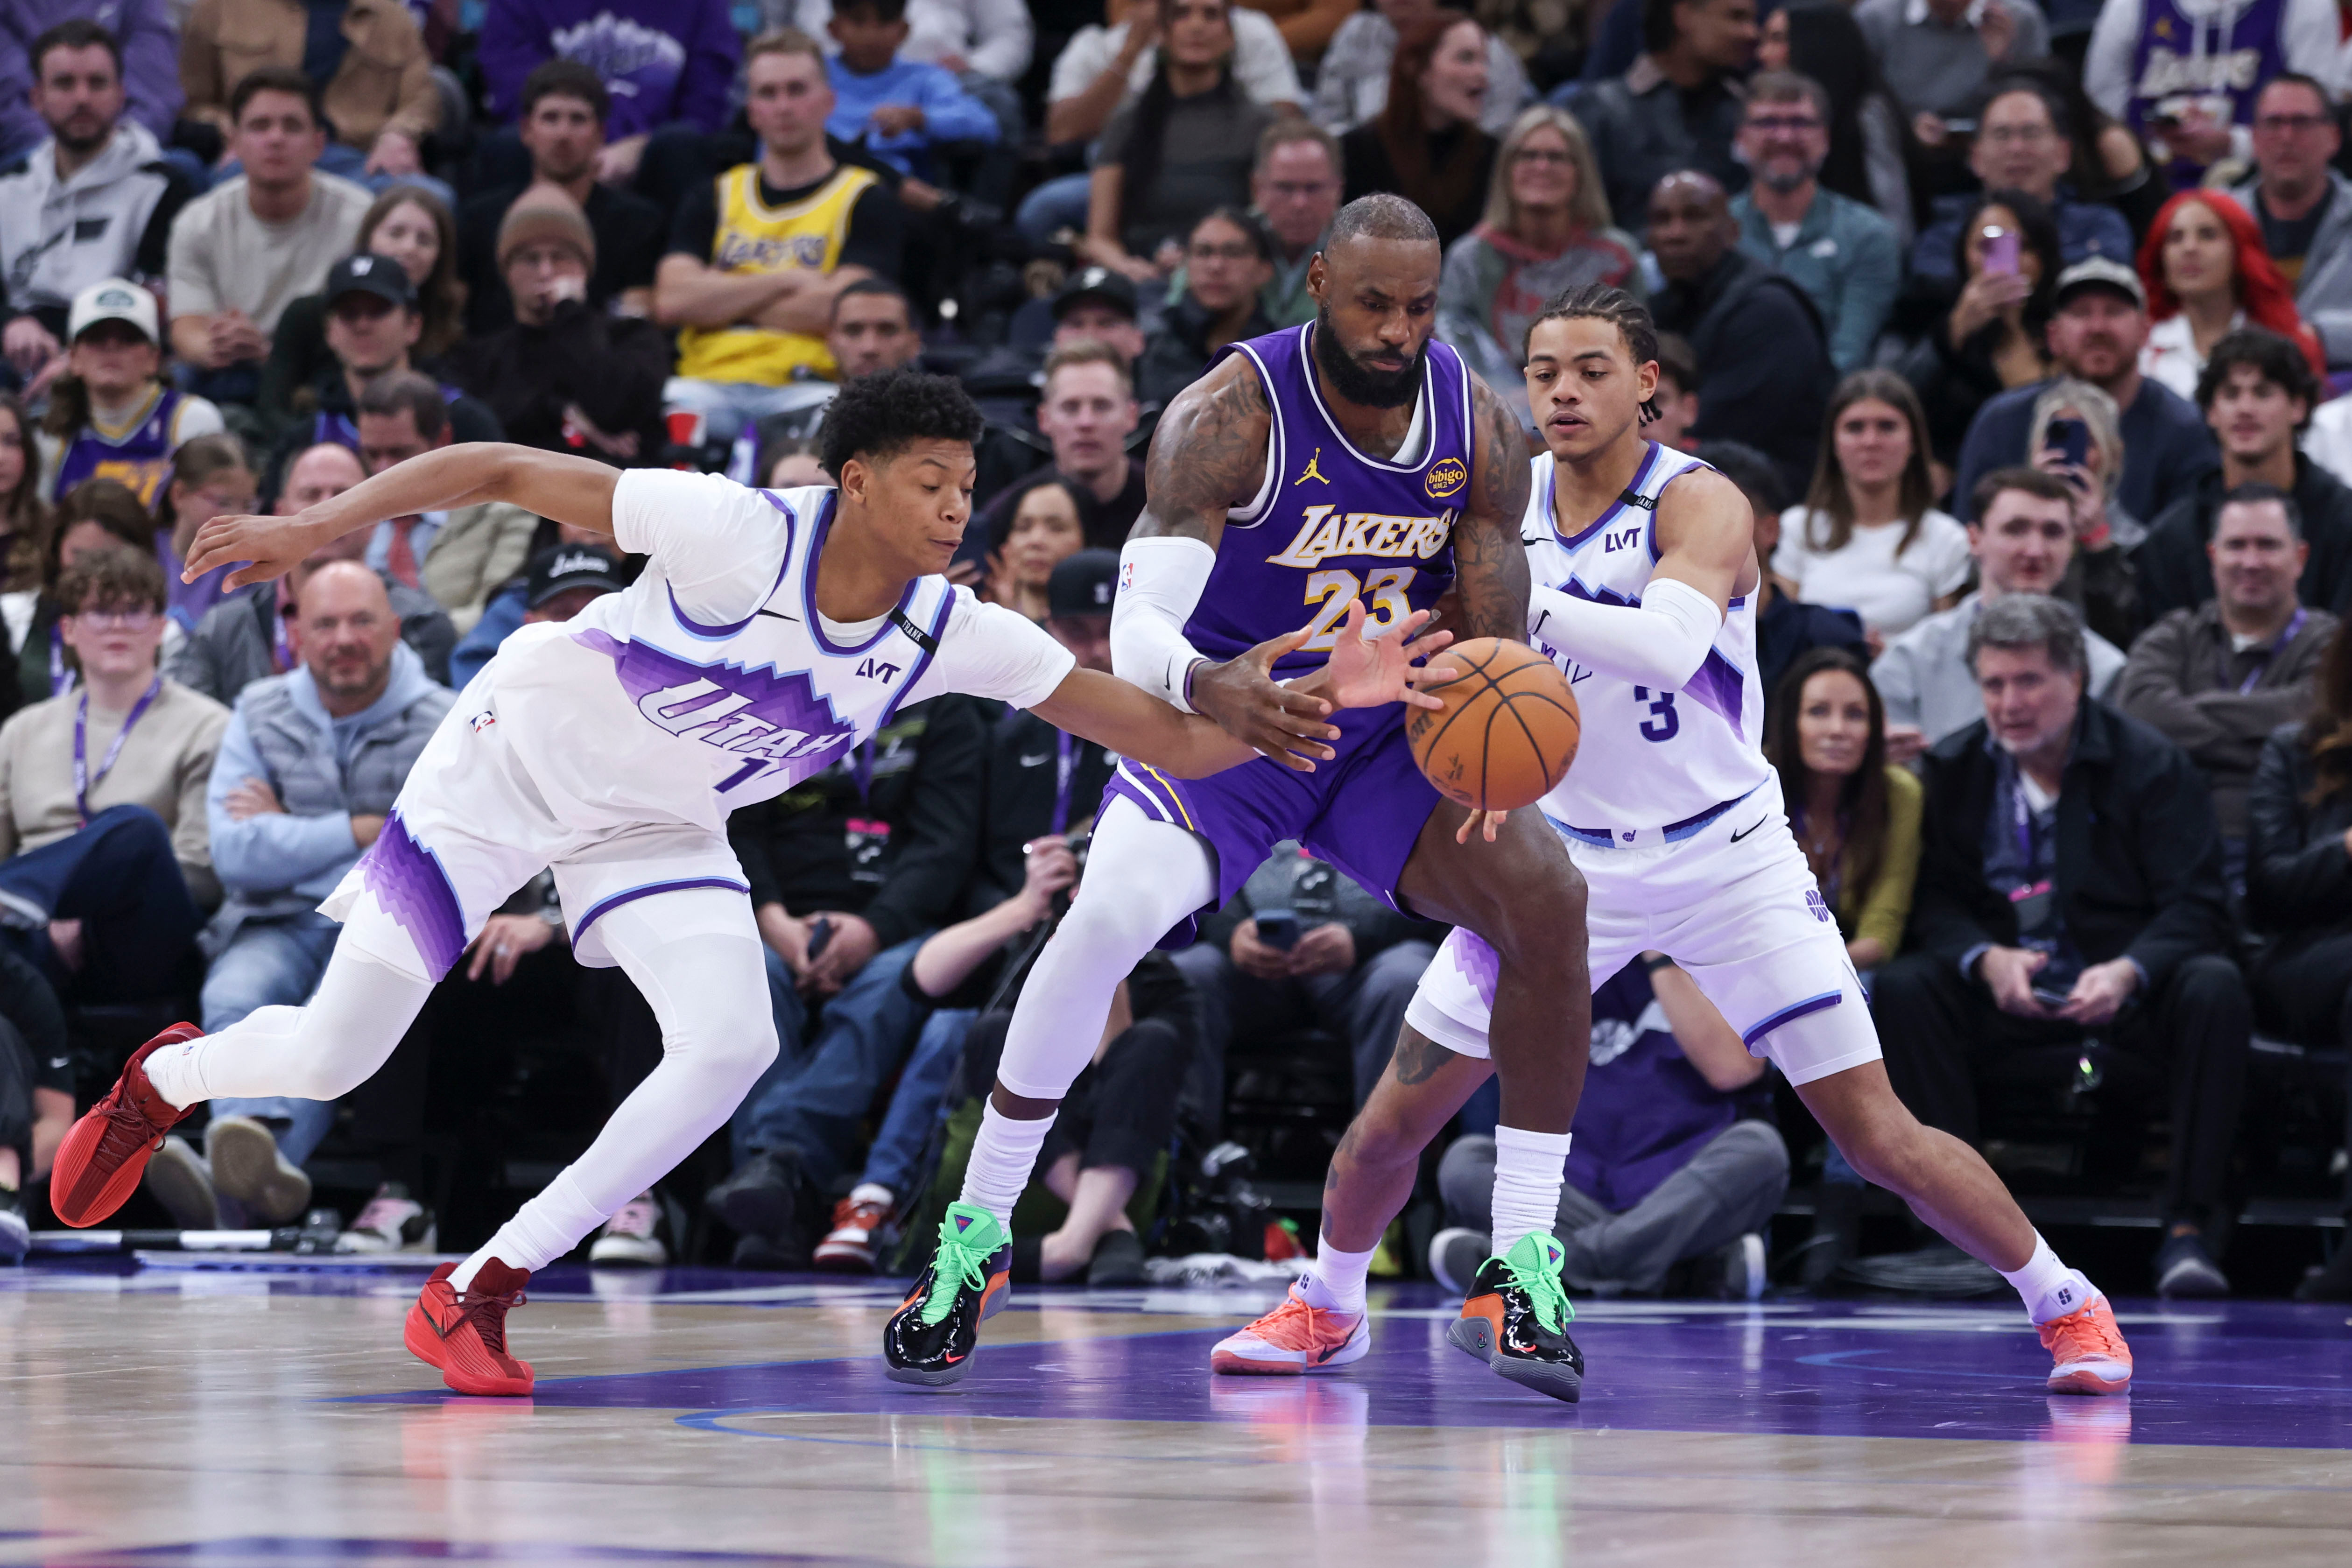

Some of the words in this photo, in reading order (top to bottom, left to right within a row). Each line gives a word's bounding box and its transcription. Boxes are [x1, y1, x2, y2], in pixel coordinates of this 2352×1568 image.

[1429, 468, 1464, 485] bibigo
[1433, 481, 1448, 490] 비비고
[1265, 504, 1453, 569] LAKERS
[1605, 527, 1641, 553] LVT
[1295, 566, 1418, 652] 23
[902, 619, 924, 642] FRANK
[855, 658, 901, 684] LVT
[638, 676, 860, 758] UTAH
[1634, 685, 1680, 743] 3
[712, 757, 790, 794] 1
